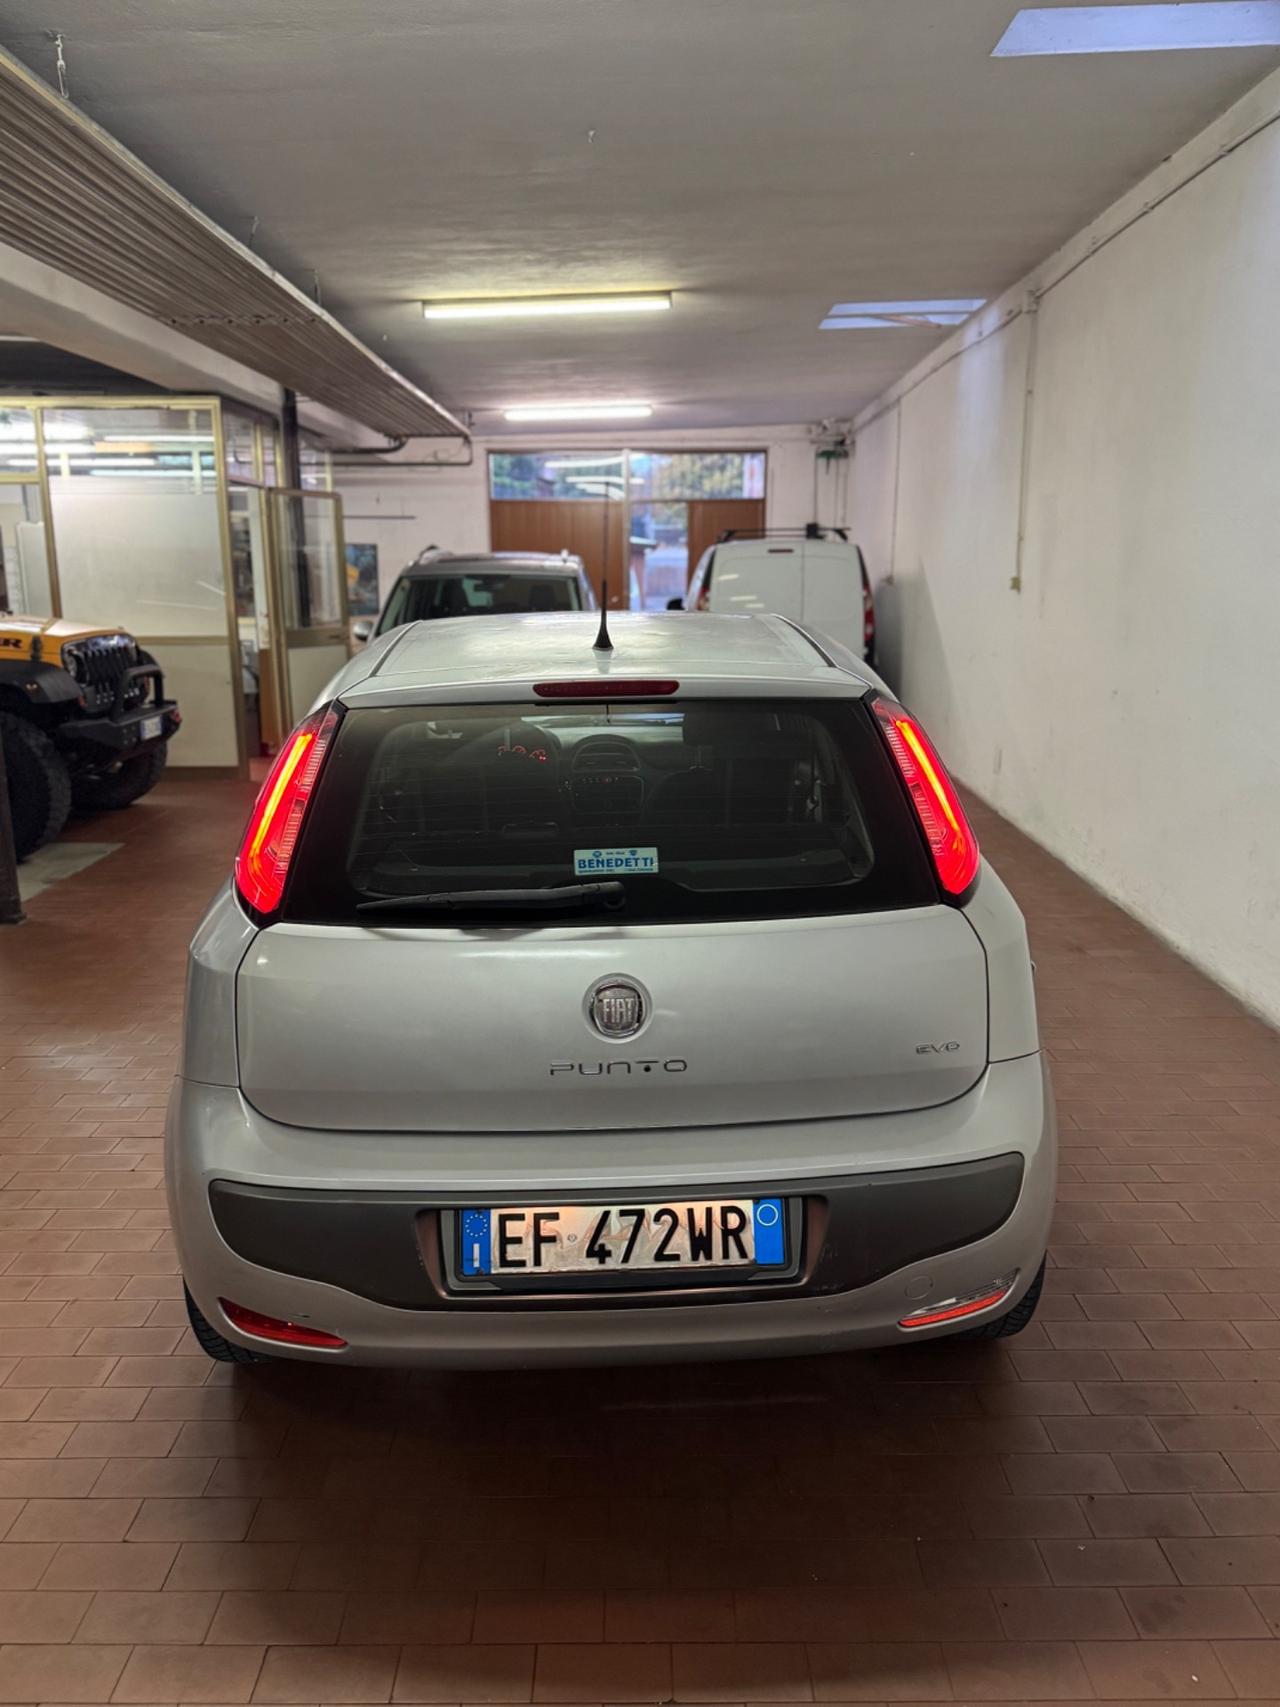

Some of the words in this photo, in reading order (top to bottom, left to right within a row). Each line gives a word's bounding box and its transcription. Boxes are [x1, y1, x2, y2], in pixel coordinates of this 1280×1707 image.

[578, 857, 654, 869] BENEDETTI
[602, 998, 634, 1023] FIAT
[915, 1041, 960, 1055] EVO
[549, 1059, 687, 1076] PUNTO
[498, 1212, 560, 1268] EF
[586, 1205, 748, 1264] 472WR
